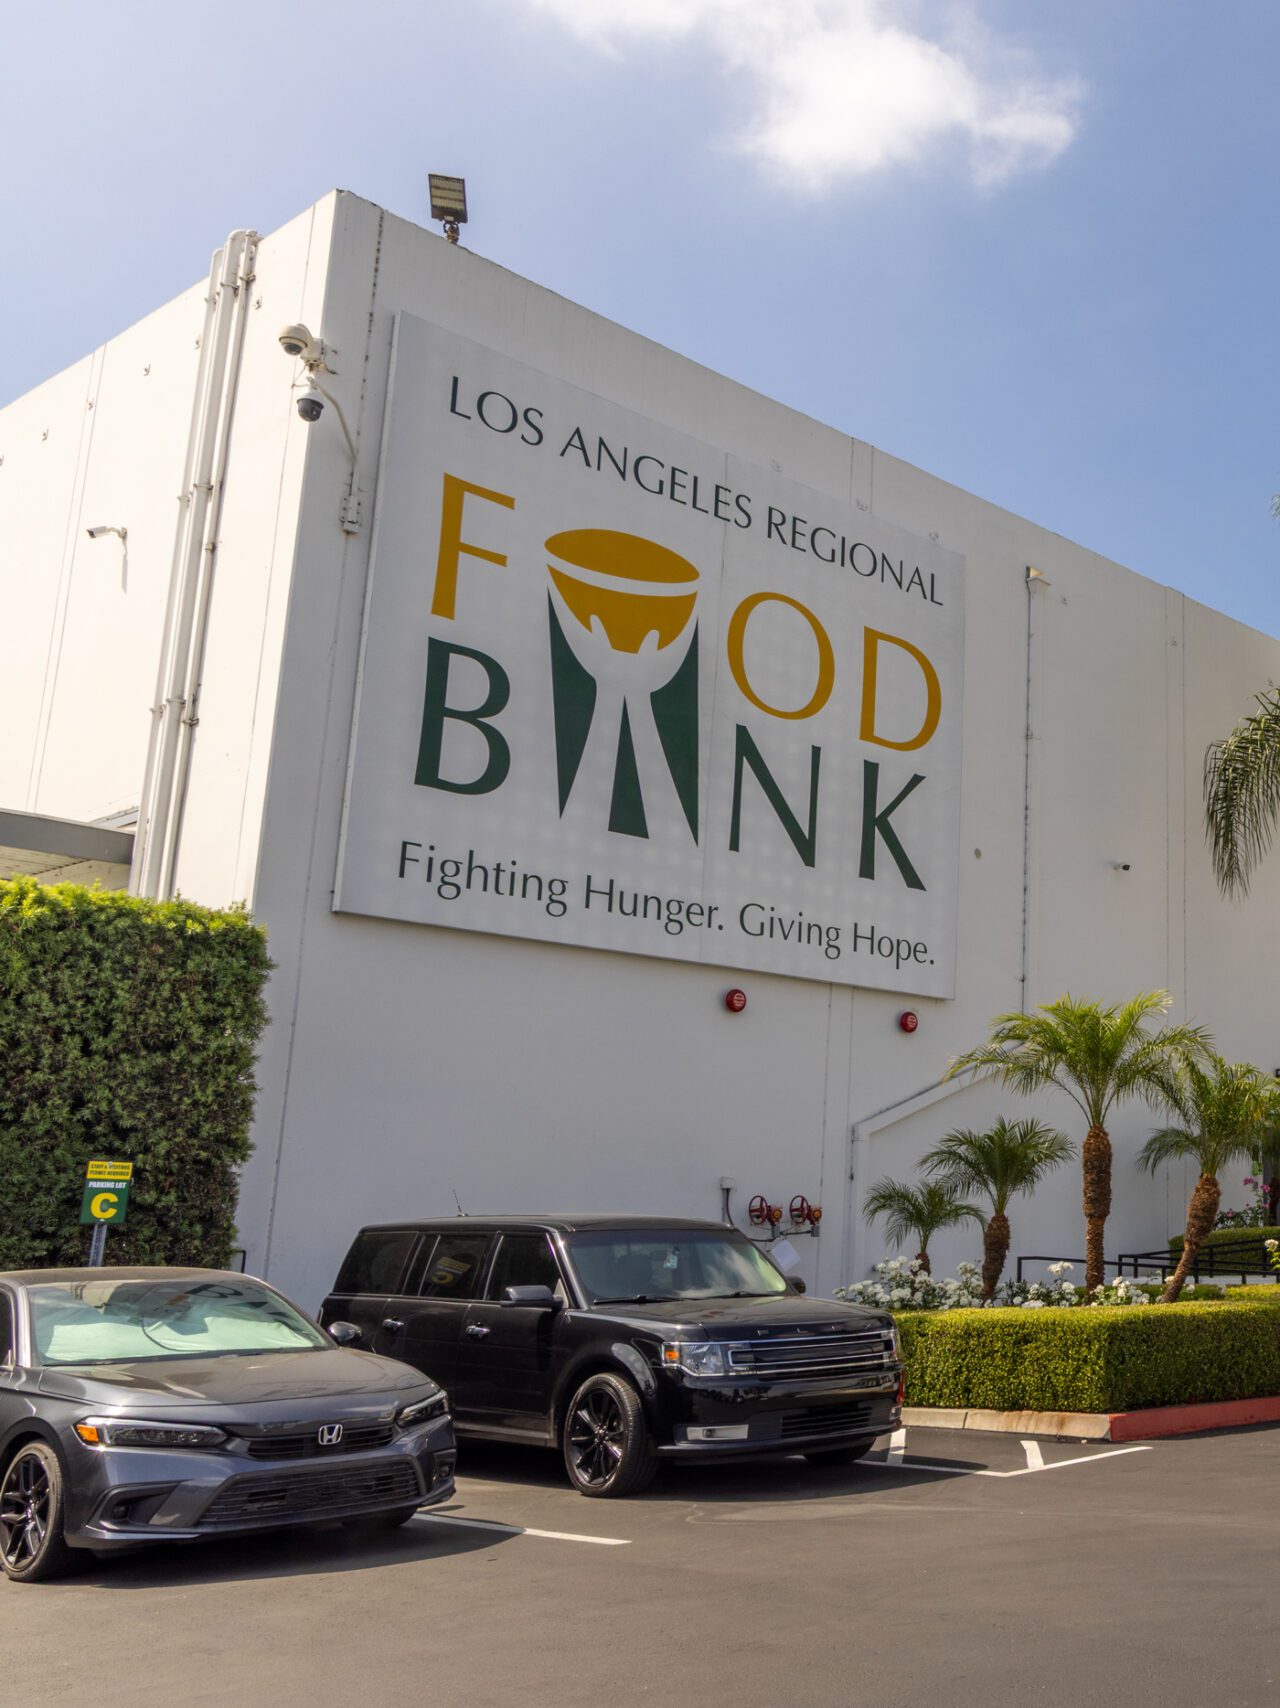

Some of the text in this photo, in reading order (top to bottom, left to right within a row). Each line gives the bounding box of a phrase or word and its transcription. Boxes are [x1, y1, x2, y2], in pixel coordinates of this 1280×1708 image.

[449, 375, 944, 607] LOS ANGELES REGIONAL
[397, 840, 936, 970] Fighting Hunger. Giving Hope.
[90, 1192, 119, 1219] C
[115, 1181, 127, 1189] LOT
